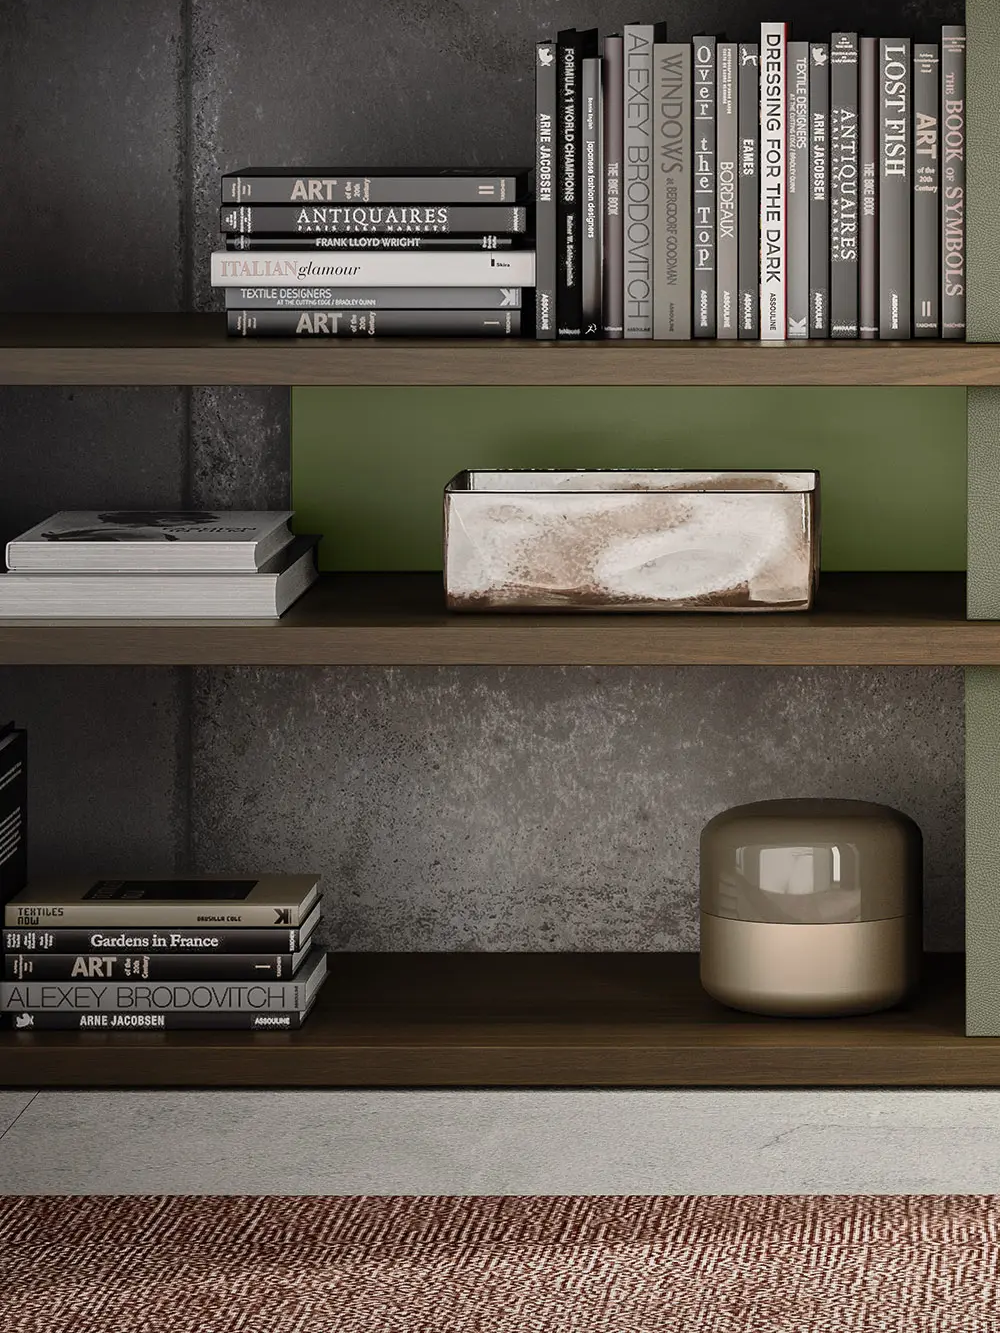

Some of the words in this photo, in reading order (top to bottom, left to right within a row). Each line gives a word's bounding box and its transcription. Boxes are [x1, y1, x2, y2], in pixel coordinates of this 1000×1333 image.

[628, 33, 649, 139] ALEXEY
[697, 46, 713, 120] Over
[766, 34, 780, 131] DRESSING
[884, 45, 906, 113] LOST
[540, 114, 551, 142] ARNE
[661, 53, 683, 173] WINDOWS
[884, 118, 906, 177] FISH
[916, 112, 936, 159] ART
[540, 145, 551, 201] JACOBSEN
[586, 141, 595, 173] japanese
[697, 138, 713, 193] the
[743, 139, 754, 175] EAMES
[766, 138, 780, 178] FOR
[290, 180, 337, 200] ART
[587, 175, 595, 201] fashion
[720, 162, 733, 238] BORDEAUX
[766, 184, 780, 222] THE
[914, 184, 938, 193] Century
[297, 208, 447, 226] ANTIQUAIRES
[586, 203, 595, 238] designers
[666, 187, 677, 235] BERGDORF
[316, 238, 348, 246] FRANK
[349, 238, 379, 246] LLOYD
[382, 237, 420, 247] WRIGHT
[628, 145, 649, 318] BRODOVITCH
[221, 261, 298, 277] ITALIAN
[297, 261, 360, 280] glamour
[666, 236, 677, 286] GOODMAN
[766, 229, 780, 283] DARK
[241, 289, 277, 298] TEXTILE
[280, 289, 332, 298] DESIGNERS
[91, 935, 149, 947] Gardens
[152, 935, 167, 947] in
[170, 935, 218, 947] France
[6, 987, 108, 1008] ALEXEY
[117, 987, 285, 1008] BRODOVITCH
[80, 1015, 107, 1025] ARNE
[110, 1015, 164, 1025] JACOBSEN
